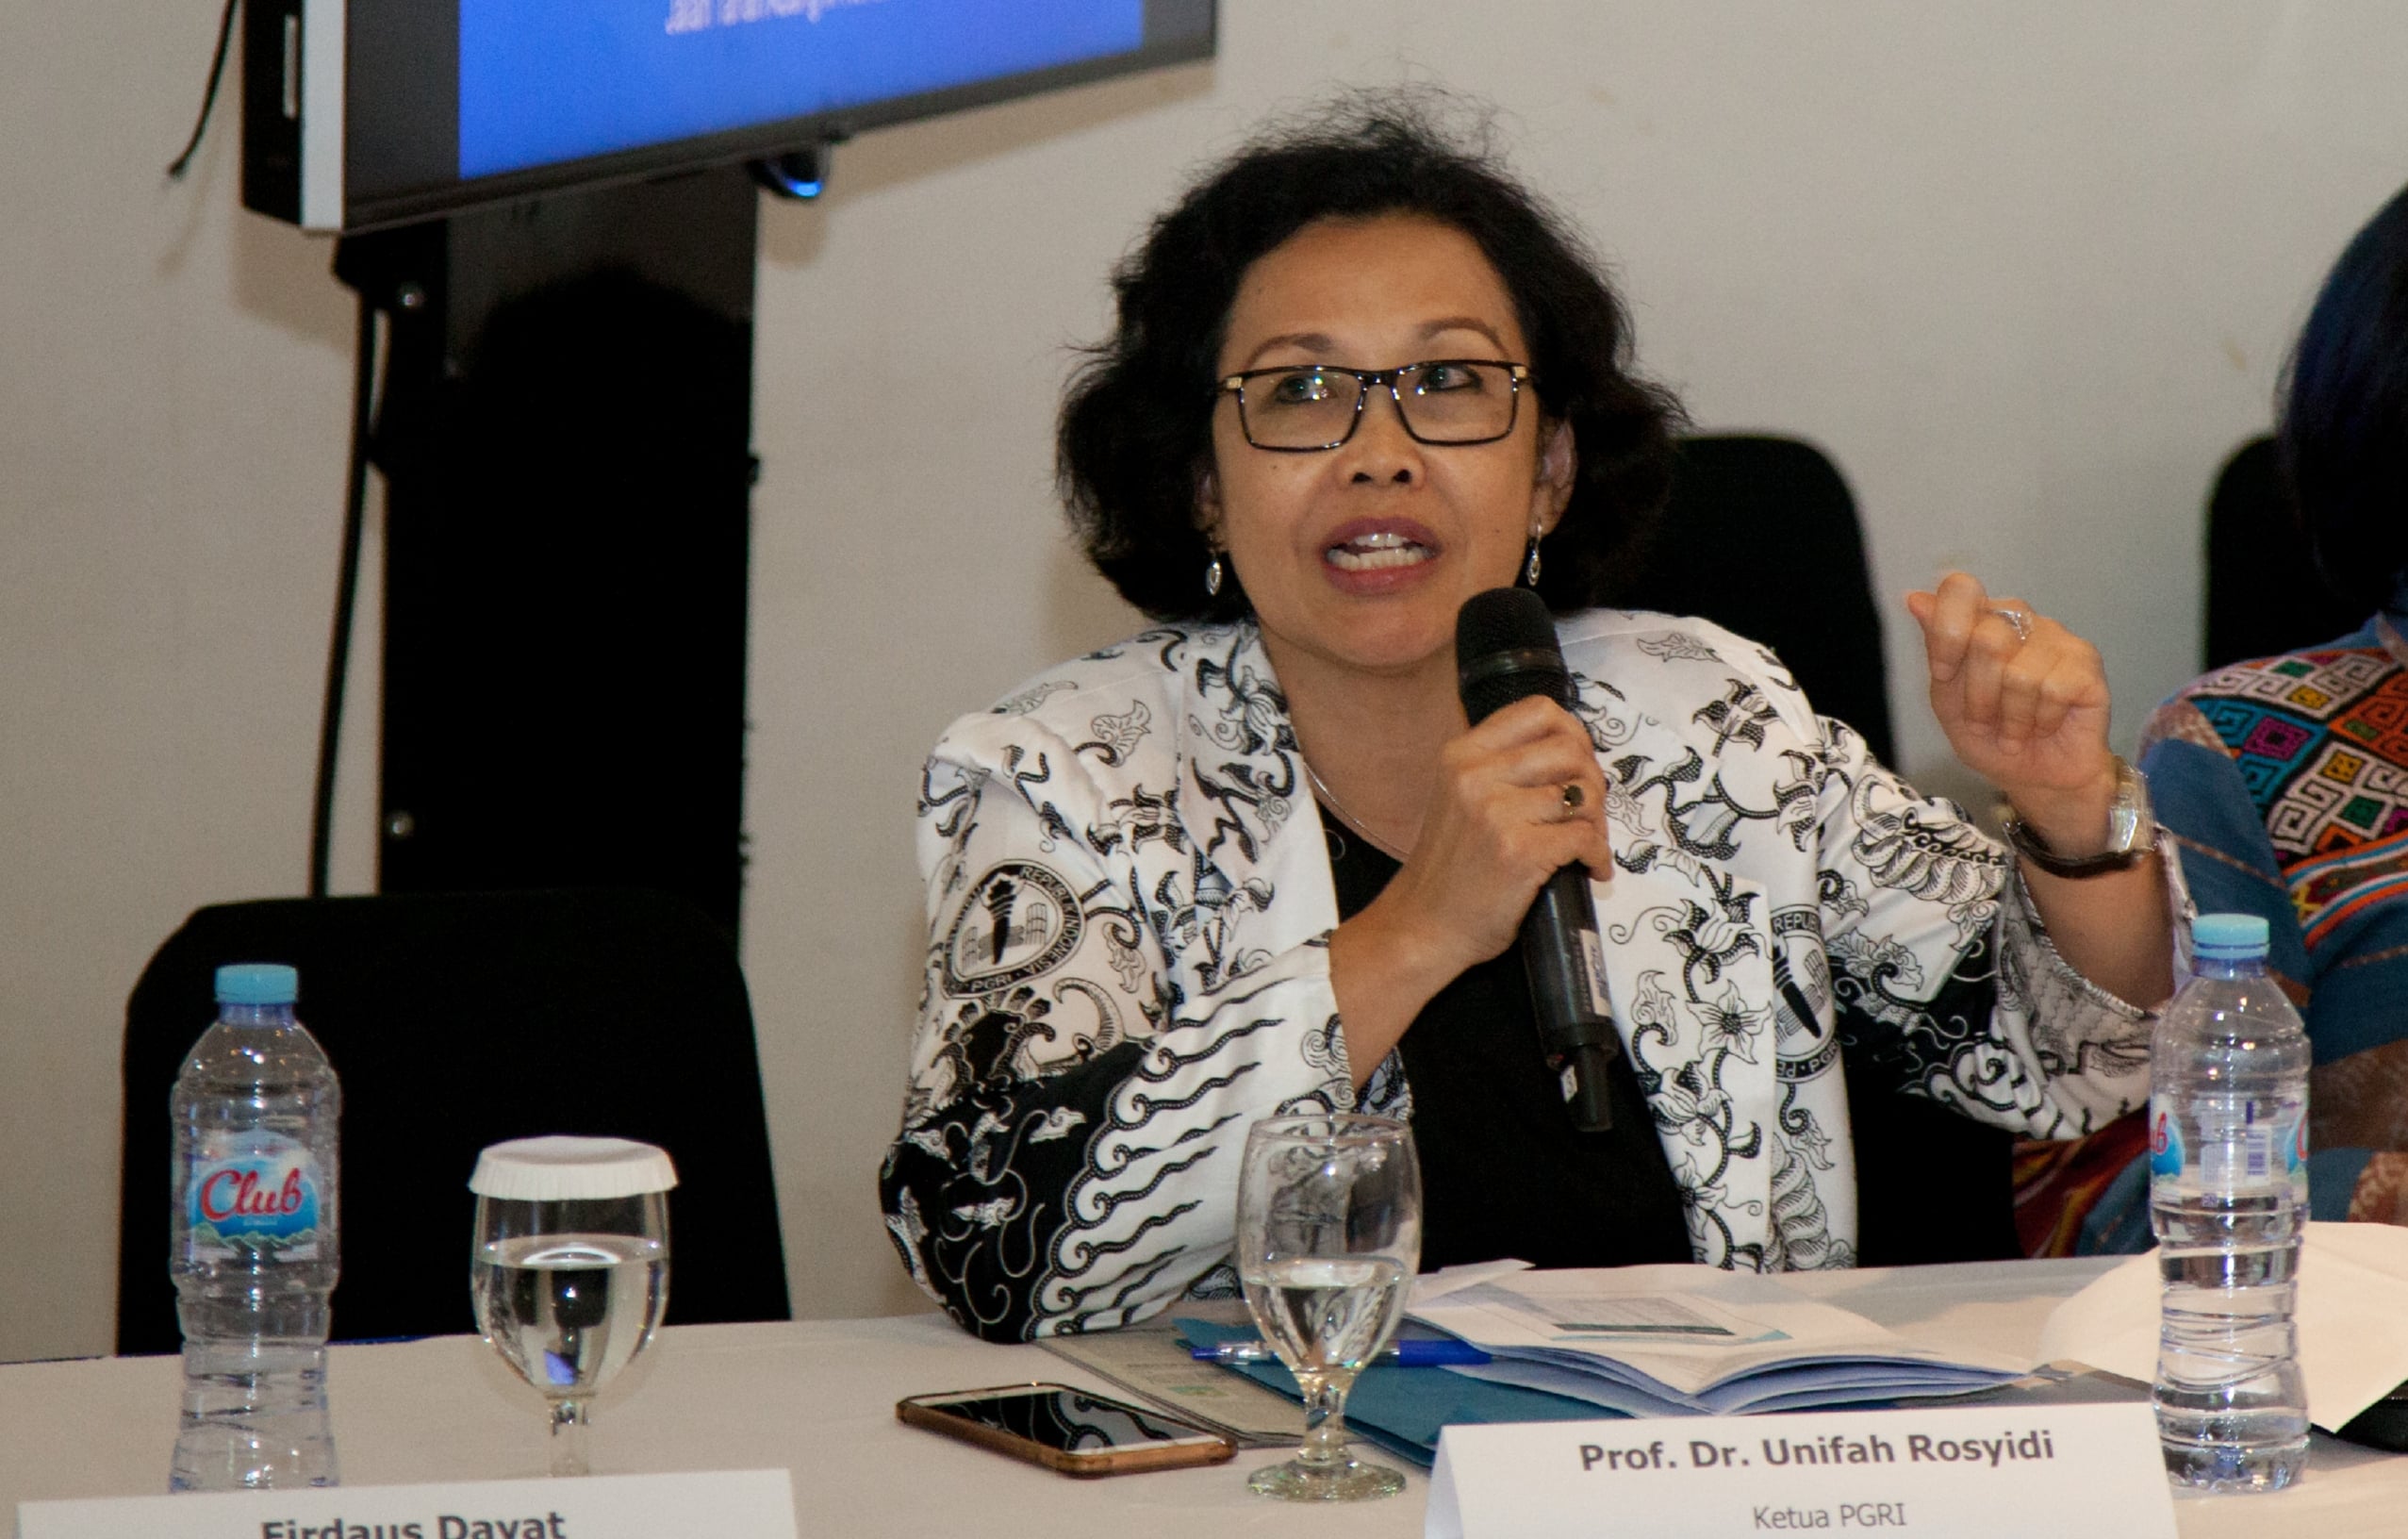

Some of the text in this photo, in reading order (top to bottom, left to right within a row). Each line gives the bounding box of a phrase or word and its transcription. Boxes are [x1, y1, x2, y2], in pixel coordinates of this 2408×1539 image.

[200, 1167, 303, 1222] Club
[1578, 1430, 2053, 1471] Prof. Dr. Unifah Rosyidi
[1752, 1502, 1907, 1531] Ketua PGRI
